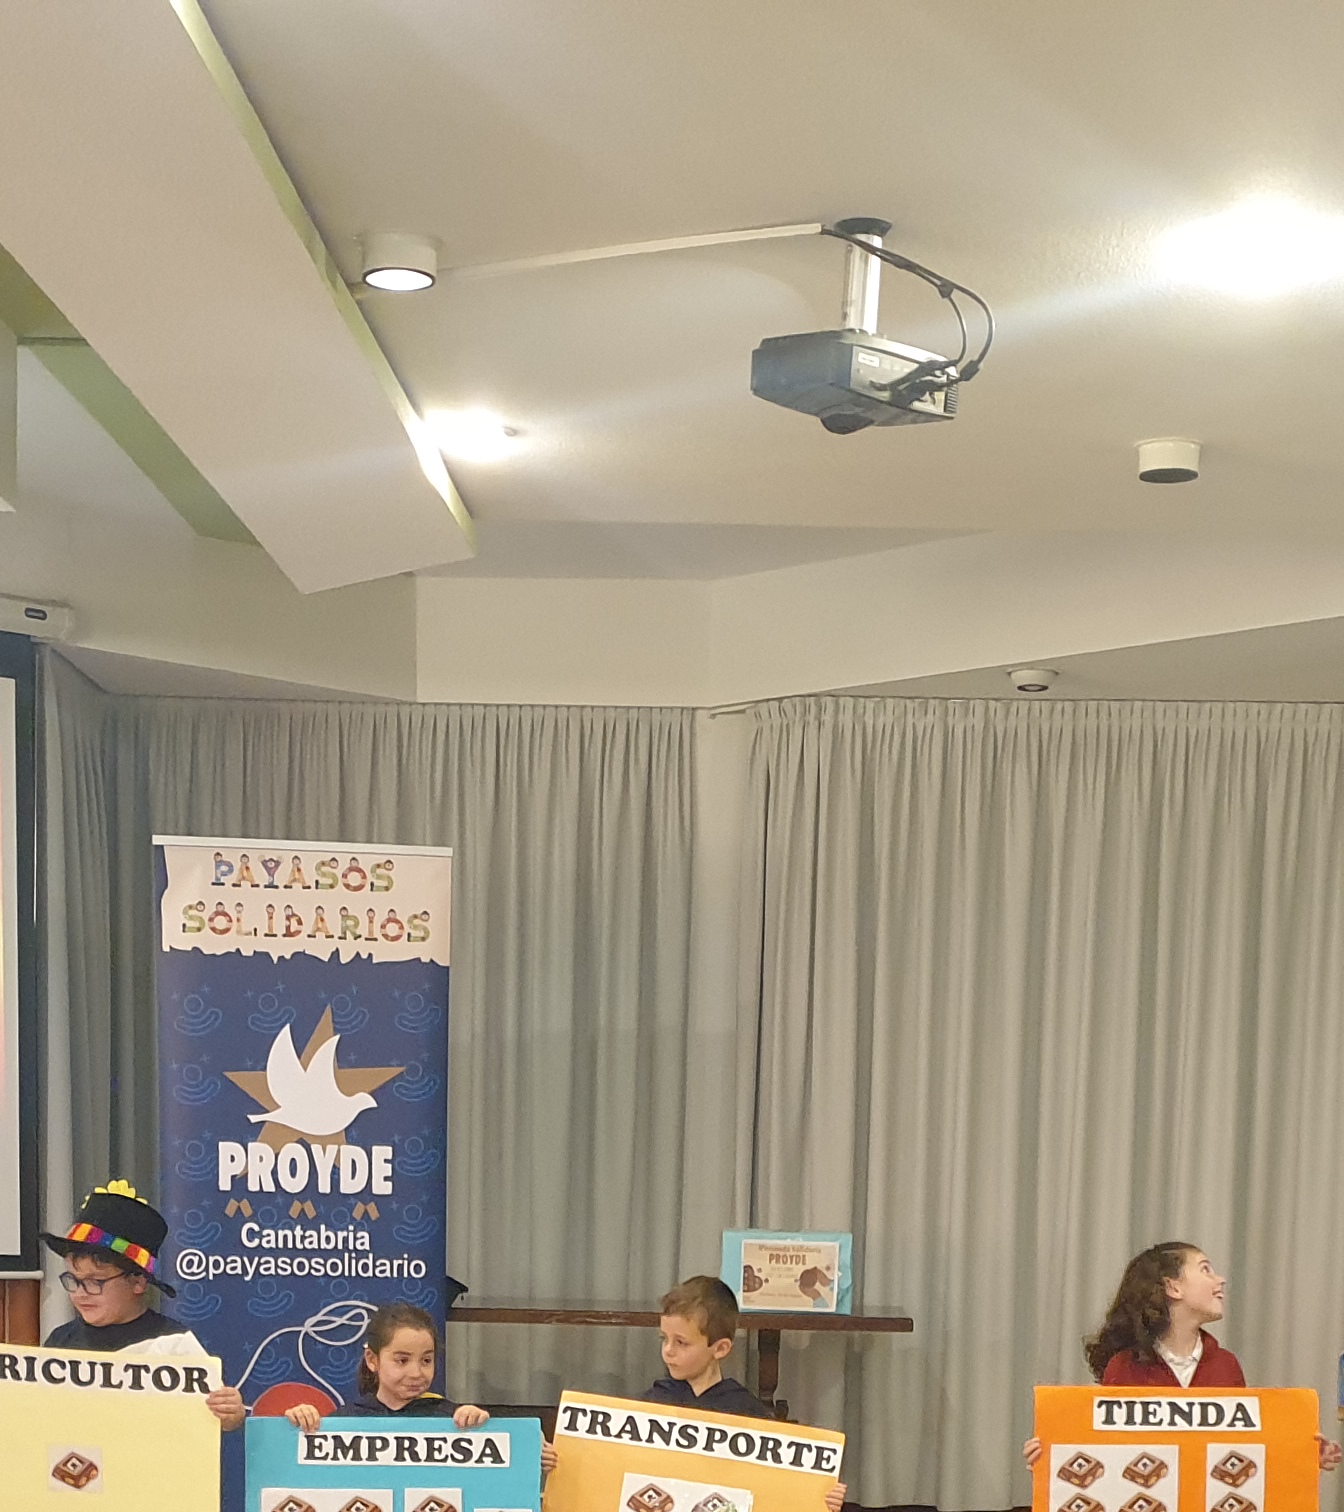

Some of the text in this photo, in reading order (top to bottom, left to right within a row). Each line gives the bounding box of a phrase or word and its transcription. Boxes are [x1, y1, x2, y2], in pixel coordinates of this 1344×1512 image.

[211, 852, 394, 892] PAYASOS
[182, 901, 430, 943] SOLIDARIOS
[218, 1141, 393, 1195] PROYDE
[241, 1222, 370, 1250] Cantabria
[176, 1248, 426, 1281] @payasosolidario
[768, 1253, 807, 1266] PROYDE
[1096, 1399, 1256, 1428] TIENDA
[303, 1434, 506, 1464] EMPRESA
[562, 1406, 838, 1474] TRANSPORTE
